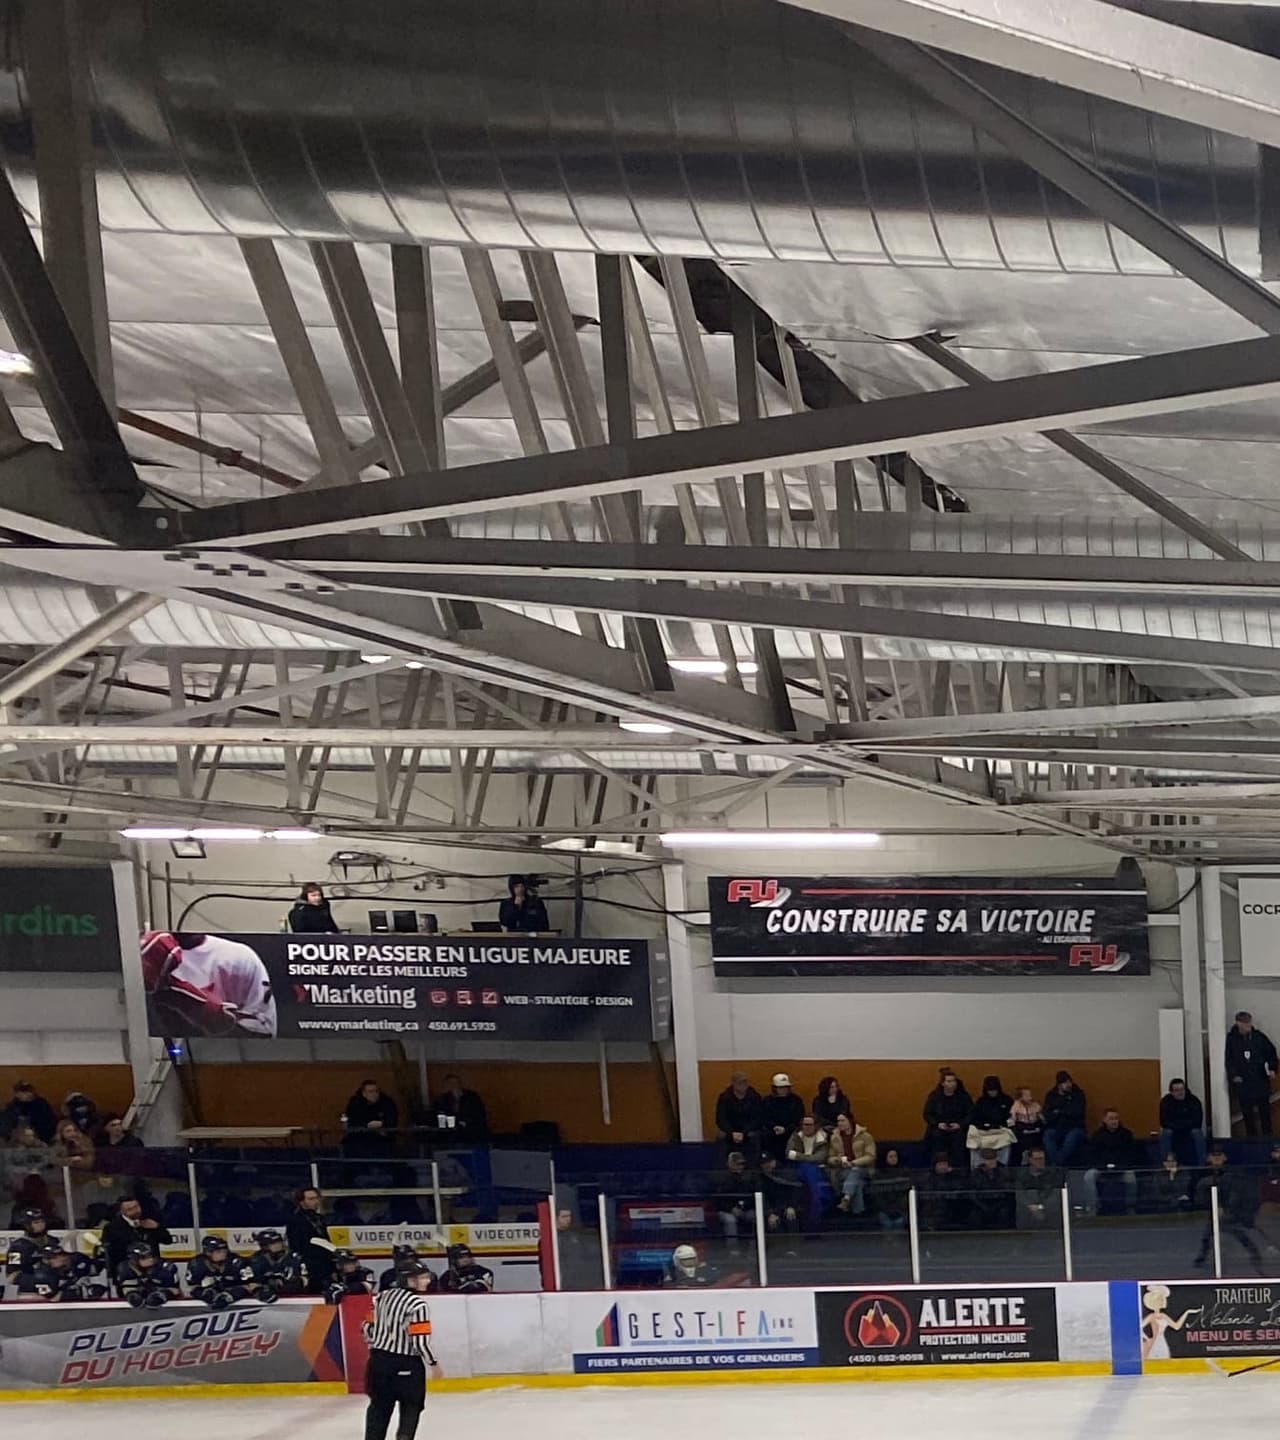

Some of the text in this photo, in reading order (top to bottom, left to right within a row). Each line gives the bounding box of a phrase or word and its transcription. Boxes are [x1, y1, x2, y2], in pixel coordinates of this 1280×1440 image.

[766, 909, 1095, 933] CONSTRUIRE SA VICTOIRE
[288, 943, 631, 965] POUR PASSER EN LIGUE MAJEURE
[288, 964, 467, 977] SIGNE AVEC LES MEILLEURS
[504, 994, 632, 1006] WEB STRATÉGIE DESIGN
[299, 1019, 419, 1031] www.ymarketing.ca
[355, 1230, 432, 1241] VIDEORON
[475, 1228, 541, 1240] VIDEOTRO
[1215, 1288, 1271, 1304] TRAITEUR
[919, 1297, 1027, 1328] ALERTE
[772, 1318, 794, 1329] INC
[69, 1309, 262, 1357] PLUS QUE
[920, 1333, 1027, 1346] PROTECTION INCENDIE
[1187, 1330, 1230, 1342] MENU
[1233, 1330, 1254, 1341] DE
[60, 1331, 280, 1385] DU HOCKEY
[587, 1353, 805, 1368] FIERS PARTENAIRES DE VOS GRENADIERS
